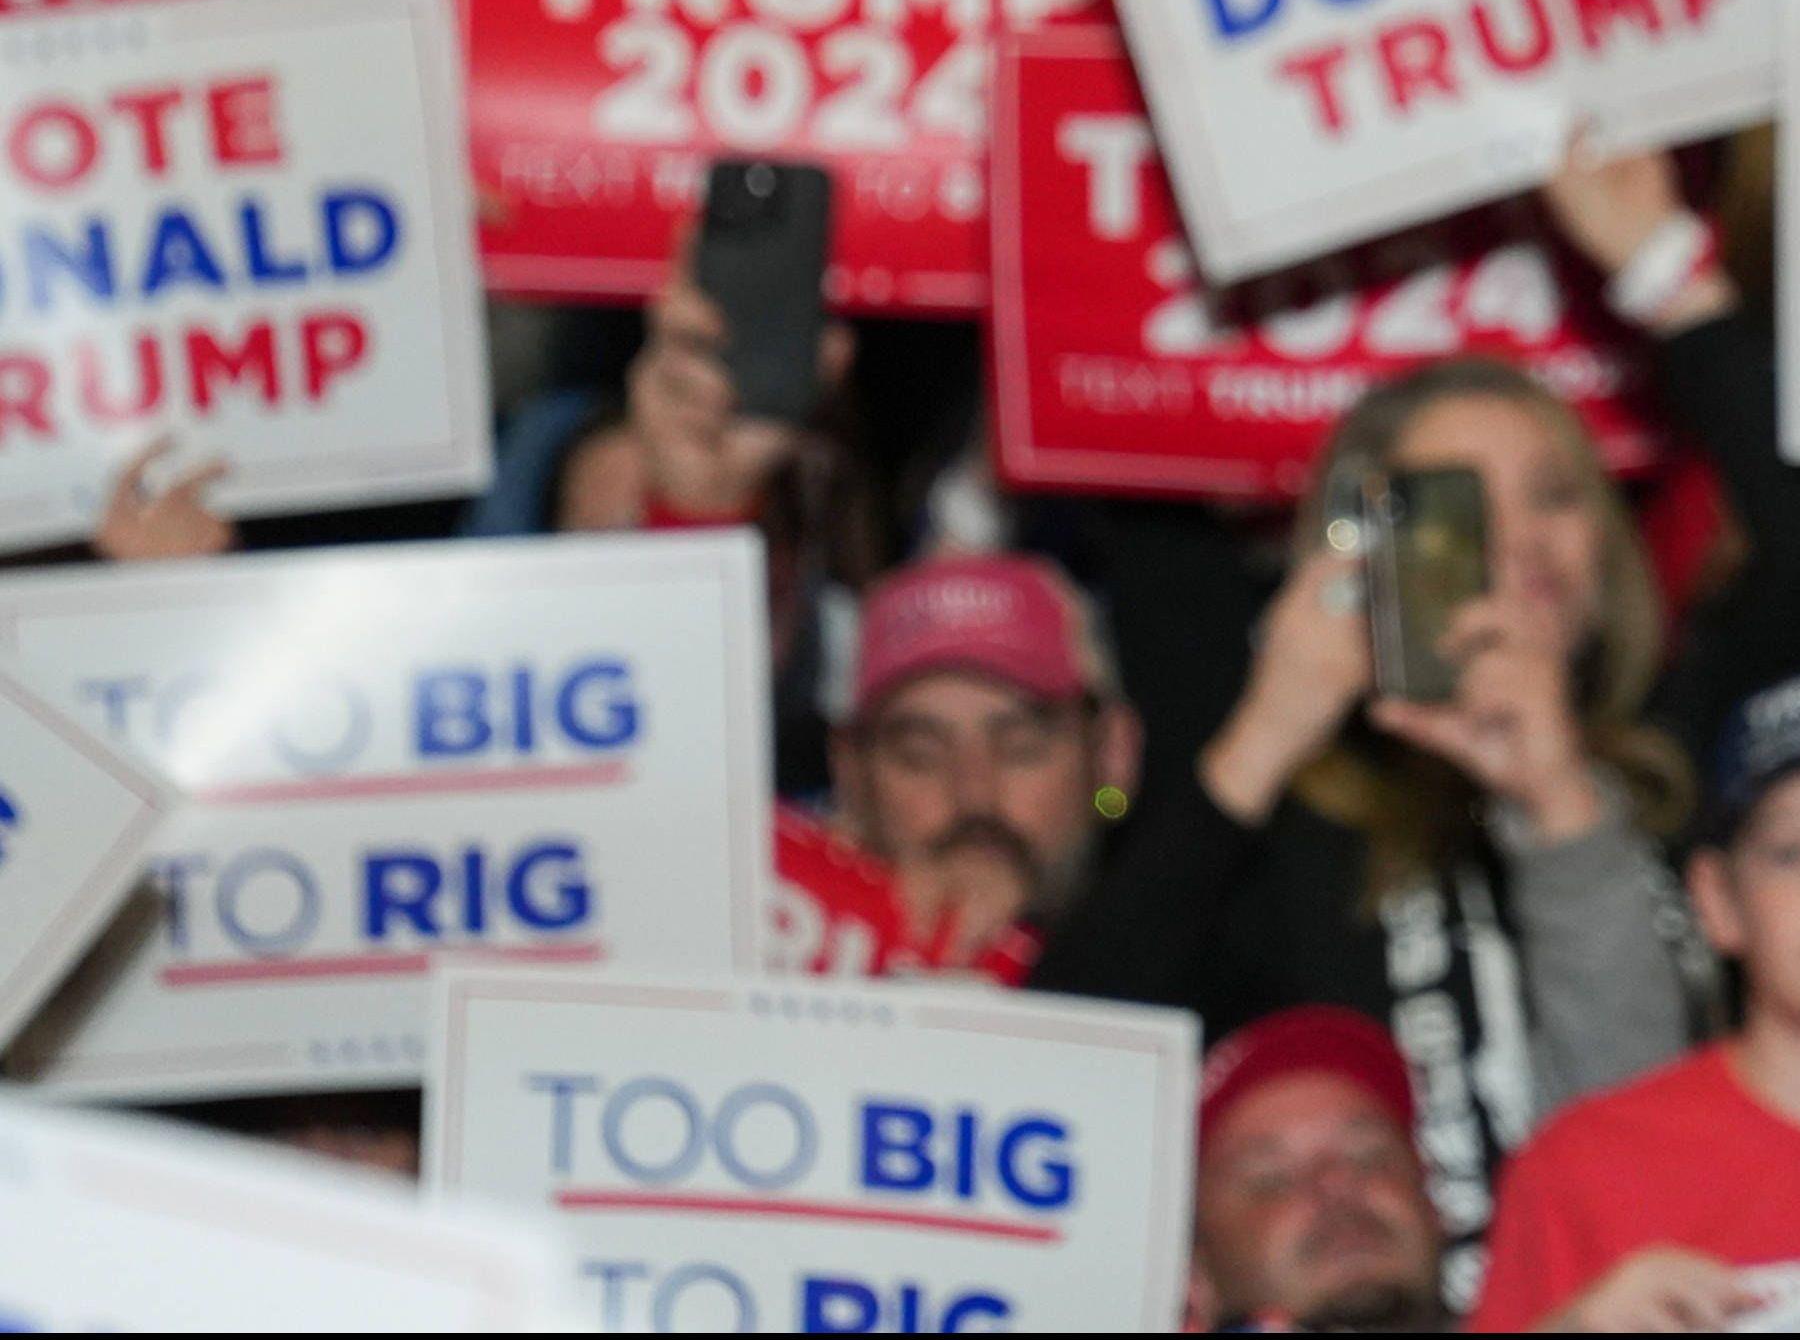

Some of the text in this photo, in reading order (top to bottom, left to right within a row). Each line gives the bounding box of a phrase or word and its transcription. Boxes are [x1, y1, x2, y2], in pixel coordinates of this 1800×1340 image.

[6, 73, 285, 192] OTE
[590, 17, 986, 150] 2024
[411, 654, 644, 760] BIG
[154, 836, 594, 959] TO RIG
[522, 1071, 1079, 1213] TOO BIG
